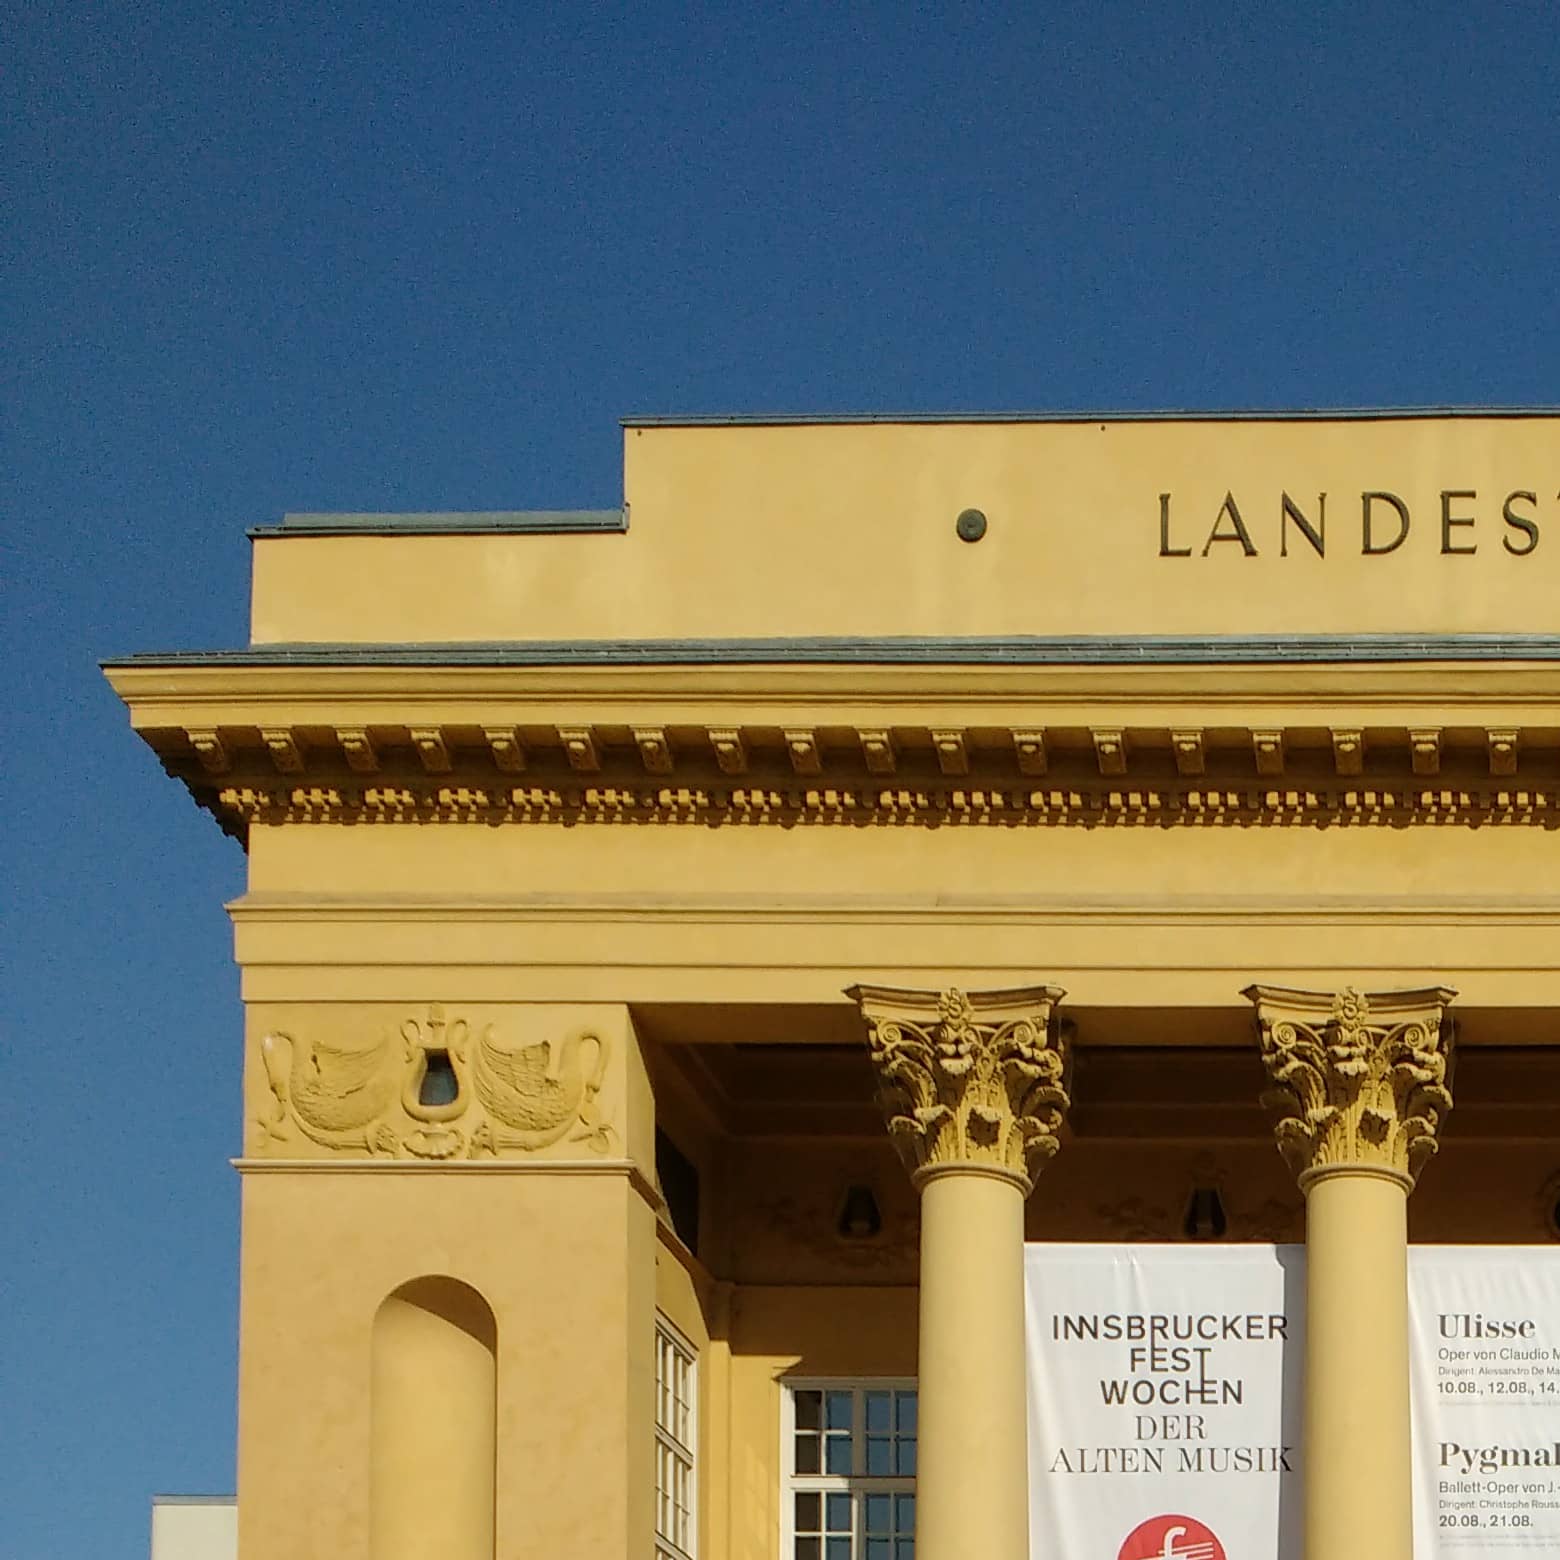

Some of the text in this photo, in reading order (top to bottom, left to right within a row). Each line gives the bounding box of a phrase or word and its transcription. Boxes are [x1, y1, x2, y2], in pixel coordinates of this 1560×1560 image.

[1052, 1315, 1289, 1341] INNSBRUCKER
[1438, 1313, 1536, 1339] Ulisse
[1130, 1347, 1212, 1373] FEST
[1438, 1347, 1470, 1362] Oper
[1473, 1350, 1496, 1360] von
[1499, 1347, 1549, 1360] Claudio
[1531, 1366, 1544, 1376] De
[1100, 1379, 1243, 1405] WOCHEN
[1437, 1381, 1484, 1396] 10.08.,
[1488, 1381, 1535, 1396] 12.08.,
[1135, 1415, 1207, 1441] DER
[1049, 1446, 1294, 1473] ALTEN MUSIK
[1439, 1480, 1518, 1496] Ballett-Oper
[1522, 1483, 1545, 1493] von
[1439, 1514, 1534, 1528] 20.08., 21.08.
